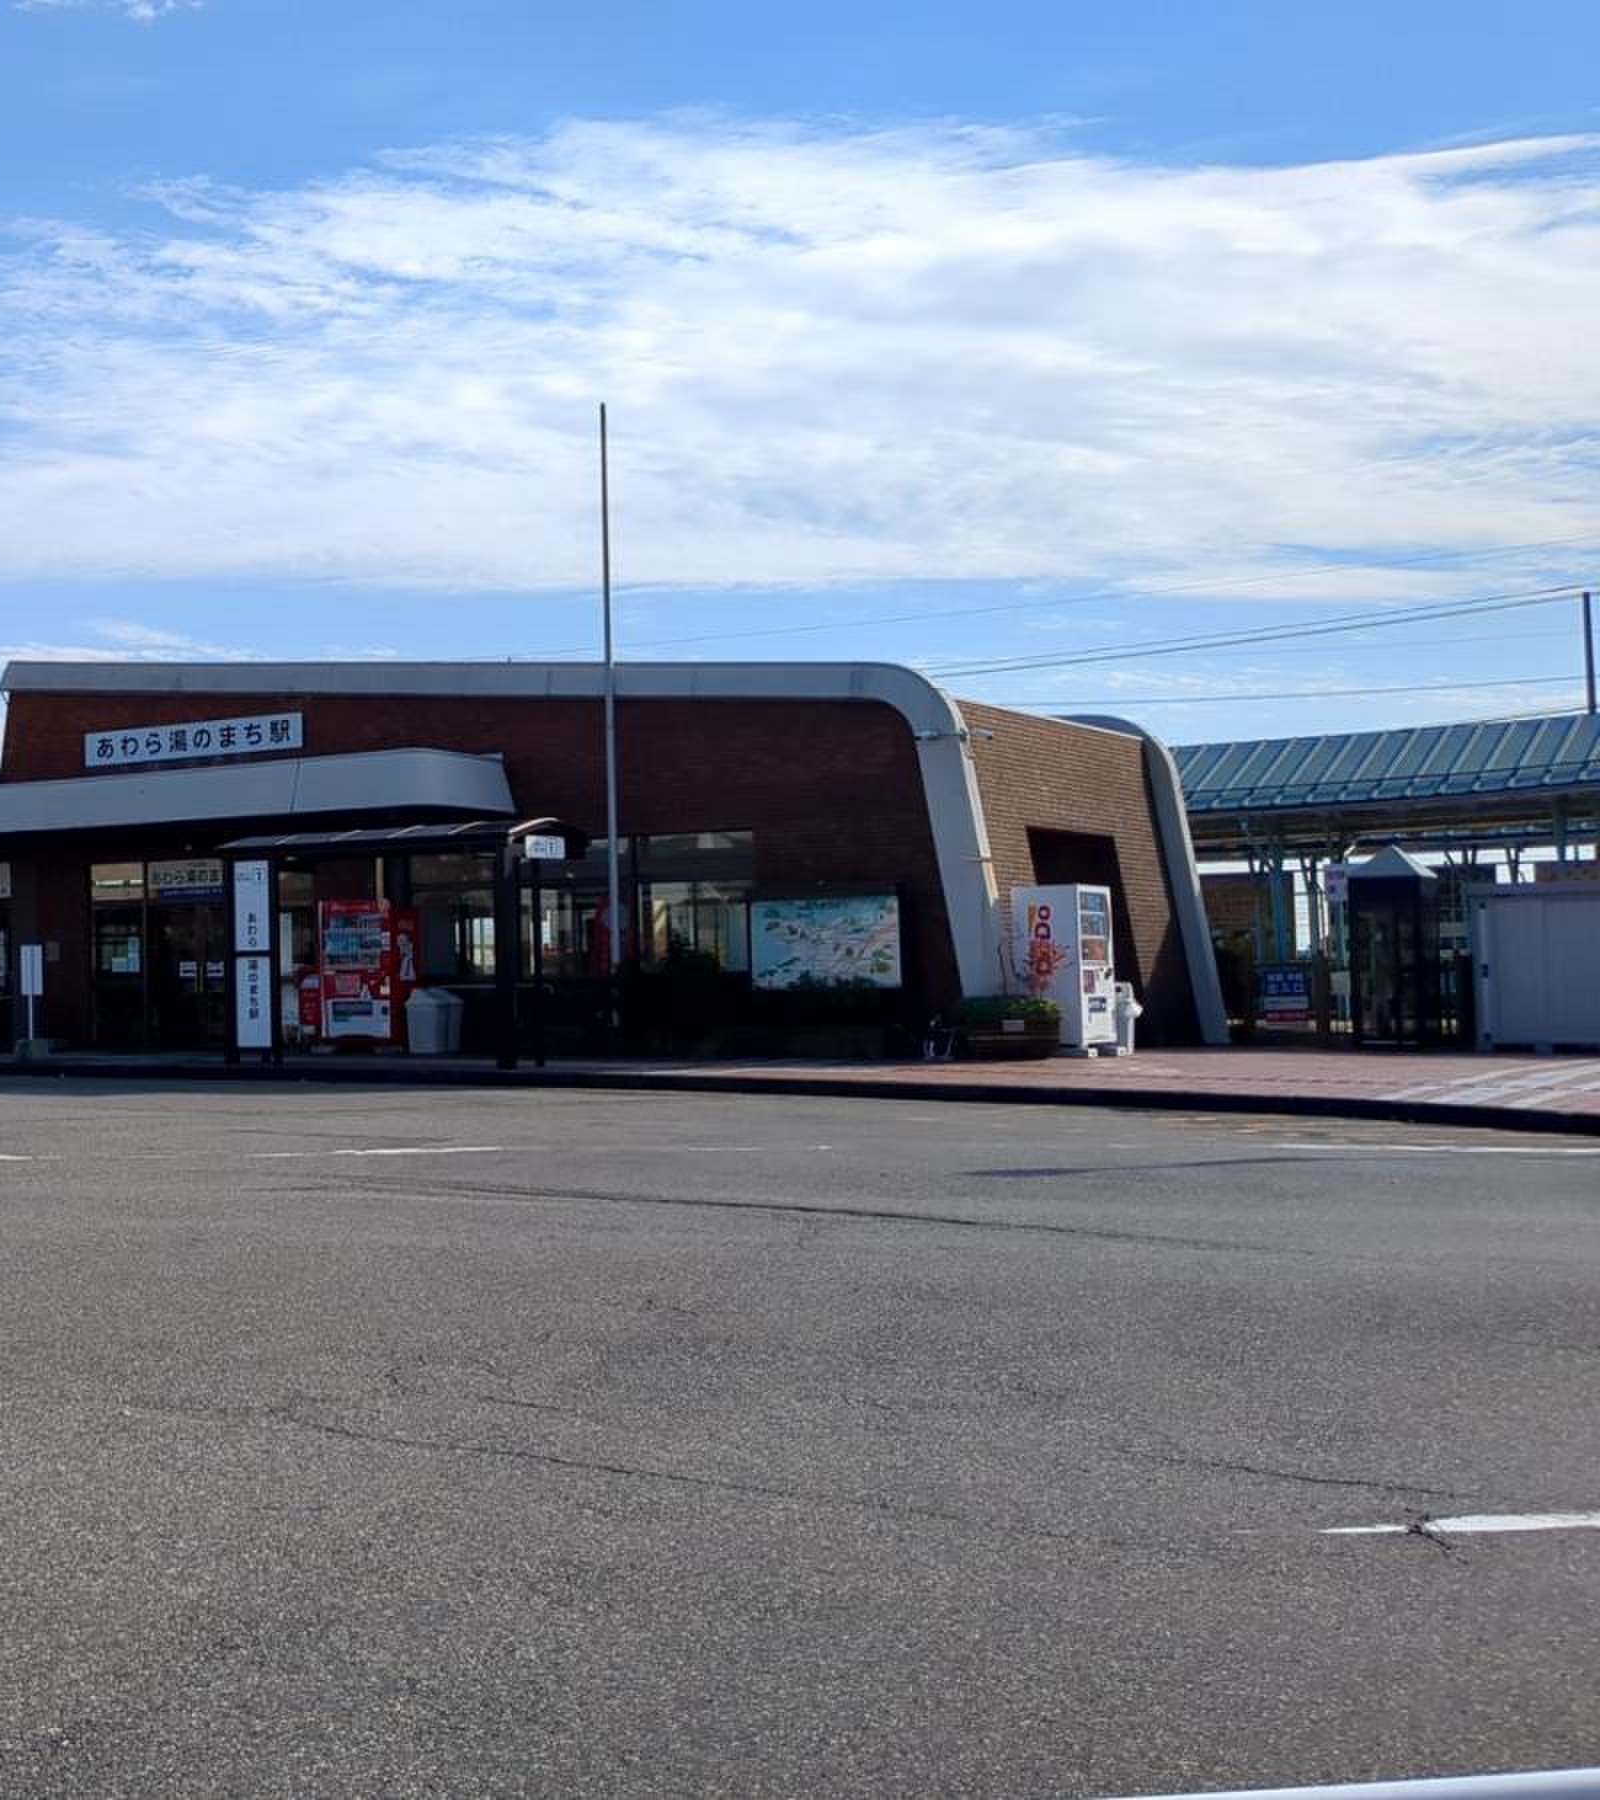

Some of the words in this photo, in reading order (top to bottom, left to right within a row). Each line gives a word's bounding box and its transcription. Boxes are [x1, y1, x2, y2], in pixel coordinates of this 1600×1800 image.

[96, 719, 291, 759] あわら湯のまち駅
